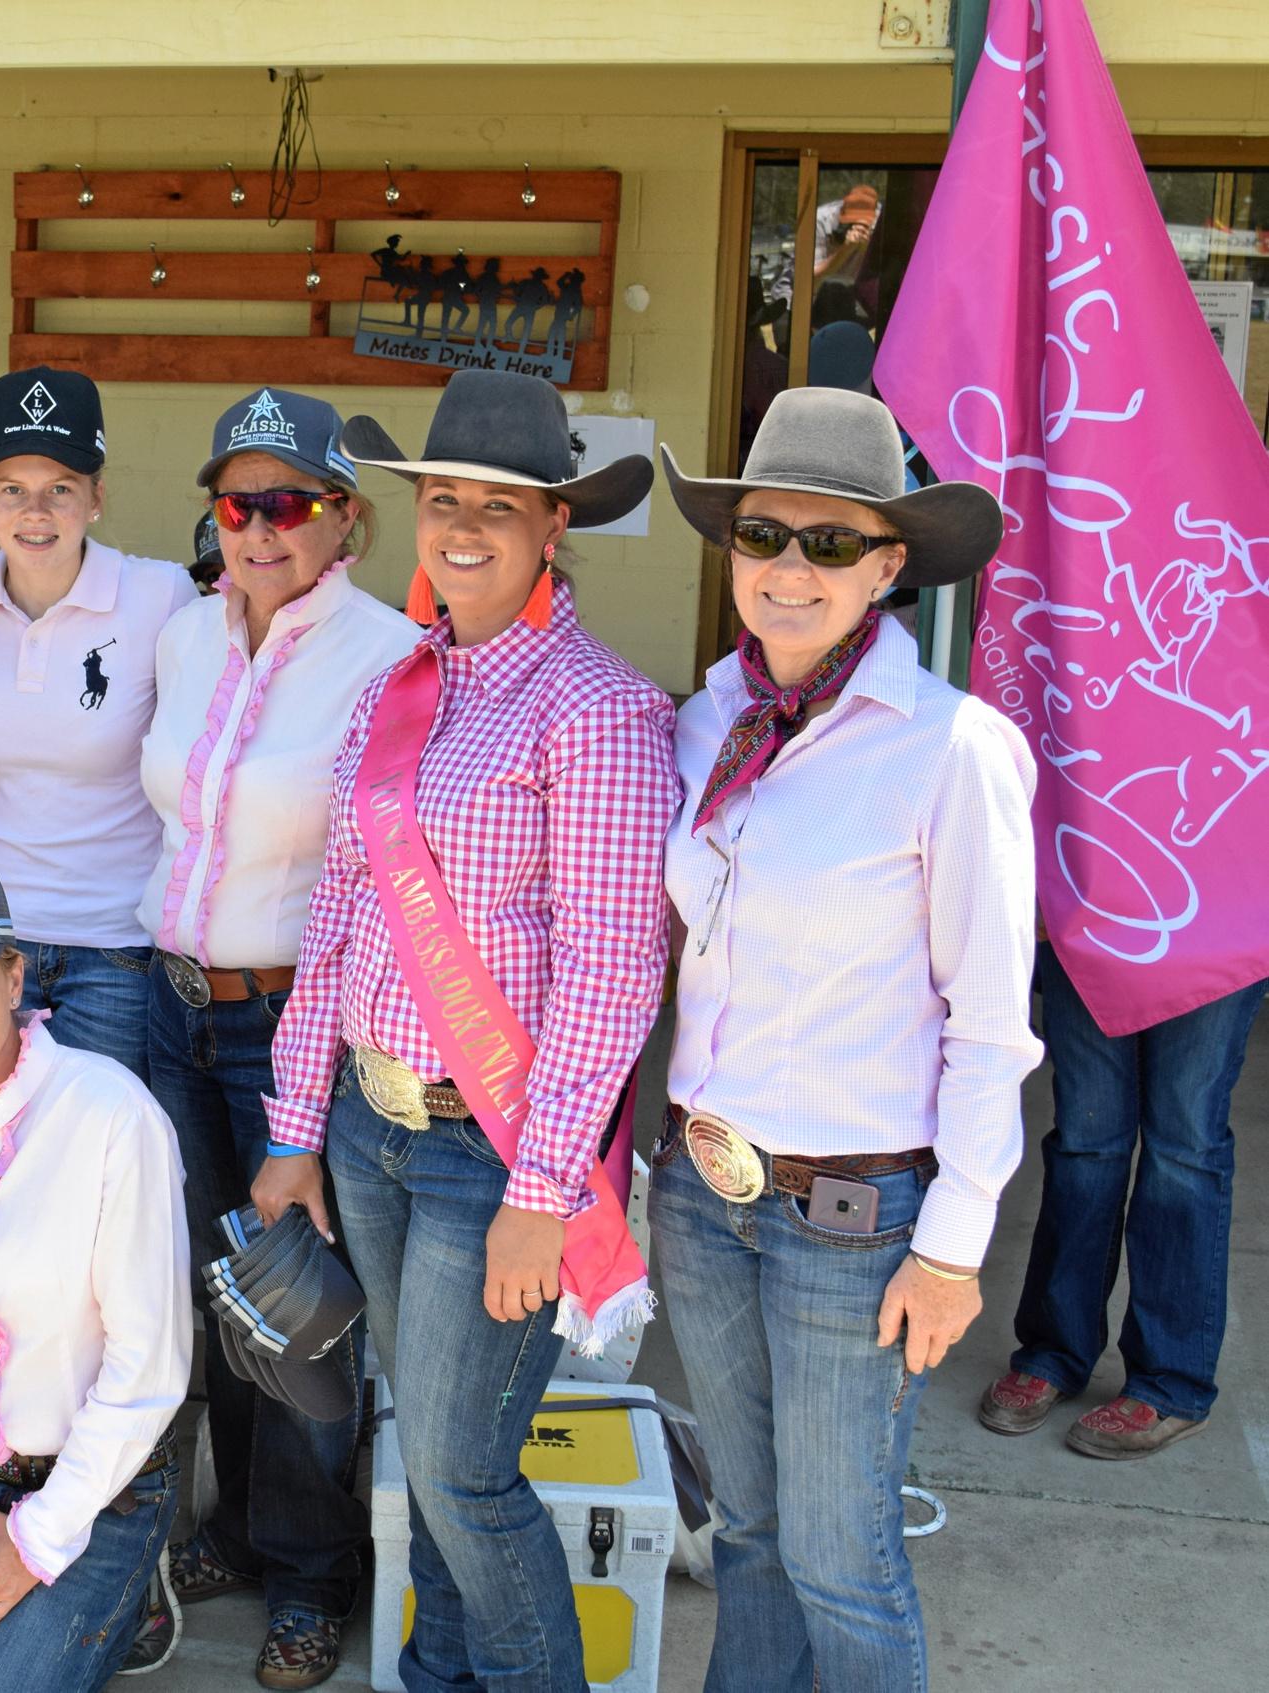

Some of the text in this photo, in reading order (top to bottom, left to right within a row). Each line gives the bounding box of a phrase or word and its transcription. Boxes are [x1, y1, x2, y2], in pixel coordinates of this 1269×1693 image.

[369, 337, 554, 379] Mates Drink Here
[230, 419, 296, 438] CLASSIC
[977, 609, 1034, 730] ndation
[368, 769, 417, 866] YOUNG
[387, 866, 491, 1042] AMBASSADOR
